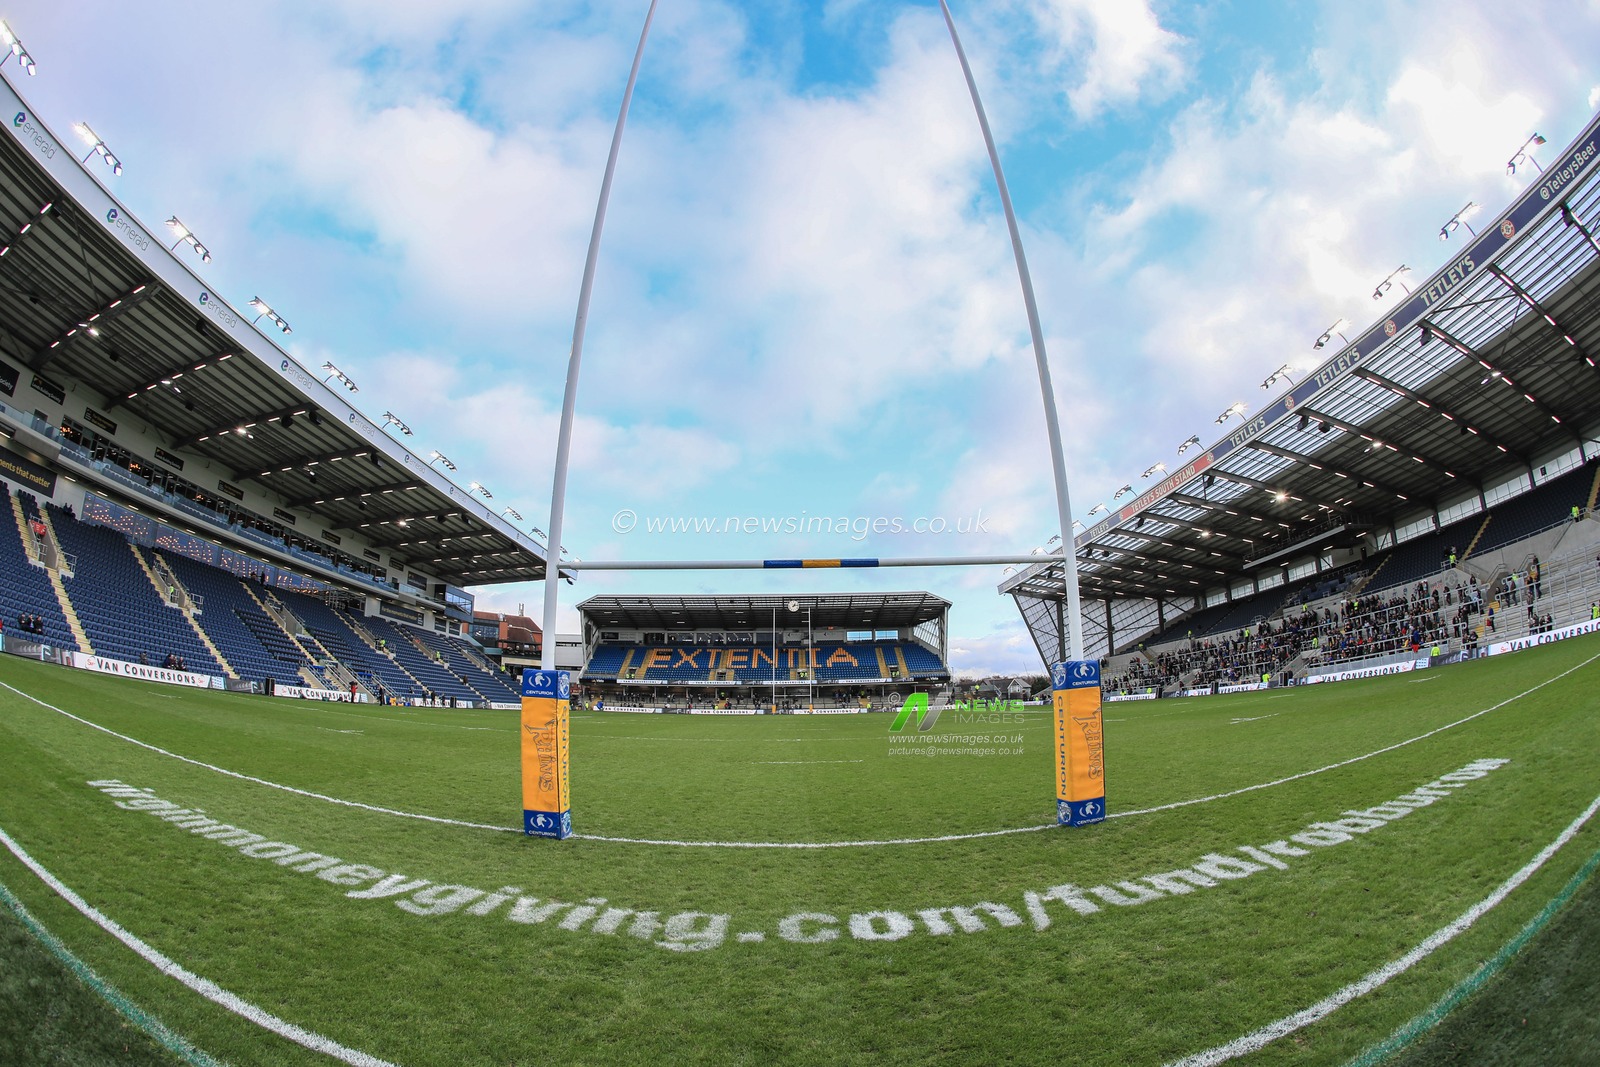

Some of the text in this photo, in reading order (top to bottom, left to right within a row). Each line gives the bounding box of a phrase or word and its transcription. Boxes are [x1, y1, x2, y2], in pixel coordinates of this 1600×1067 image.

[23, 122, 57, 159] emerald
[1540, 140, 1597, 200] @TetleysBeer
[116, 218, 150, 251] emerald
[1420, 256, 1475, 306] TETLEY'S
[208, 300, 238, 328] emerald
[288, 366, 313, 390] emerald
[1314, 348, 1360, 387] TETLEY'S
[1230, 417, 1265, 447] TETLEY'S
[16, 465, 29, 479] that
[29, 473, 51, 487] matter
[1131, 465, 1196, 513] TETLEY'S SOUTH STAND
[648, 647, 858, 669] EXTENTIA
[1510, 640, 1532, 651] VAN
[97, 656, 119, 673] VAN
[125, 663, 196, 685] CONVERSIONS
[1322, 675, 1337, 683] VAN
[1341, 665, 1400, 680] CONVERSIONS
[1058, 695, 1067, 796] CENTURION
